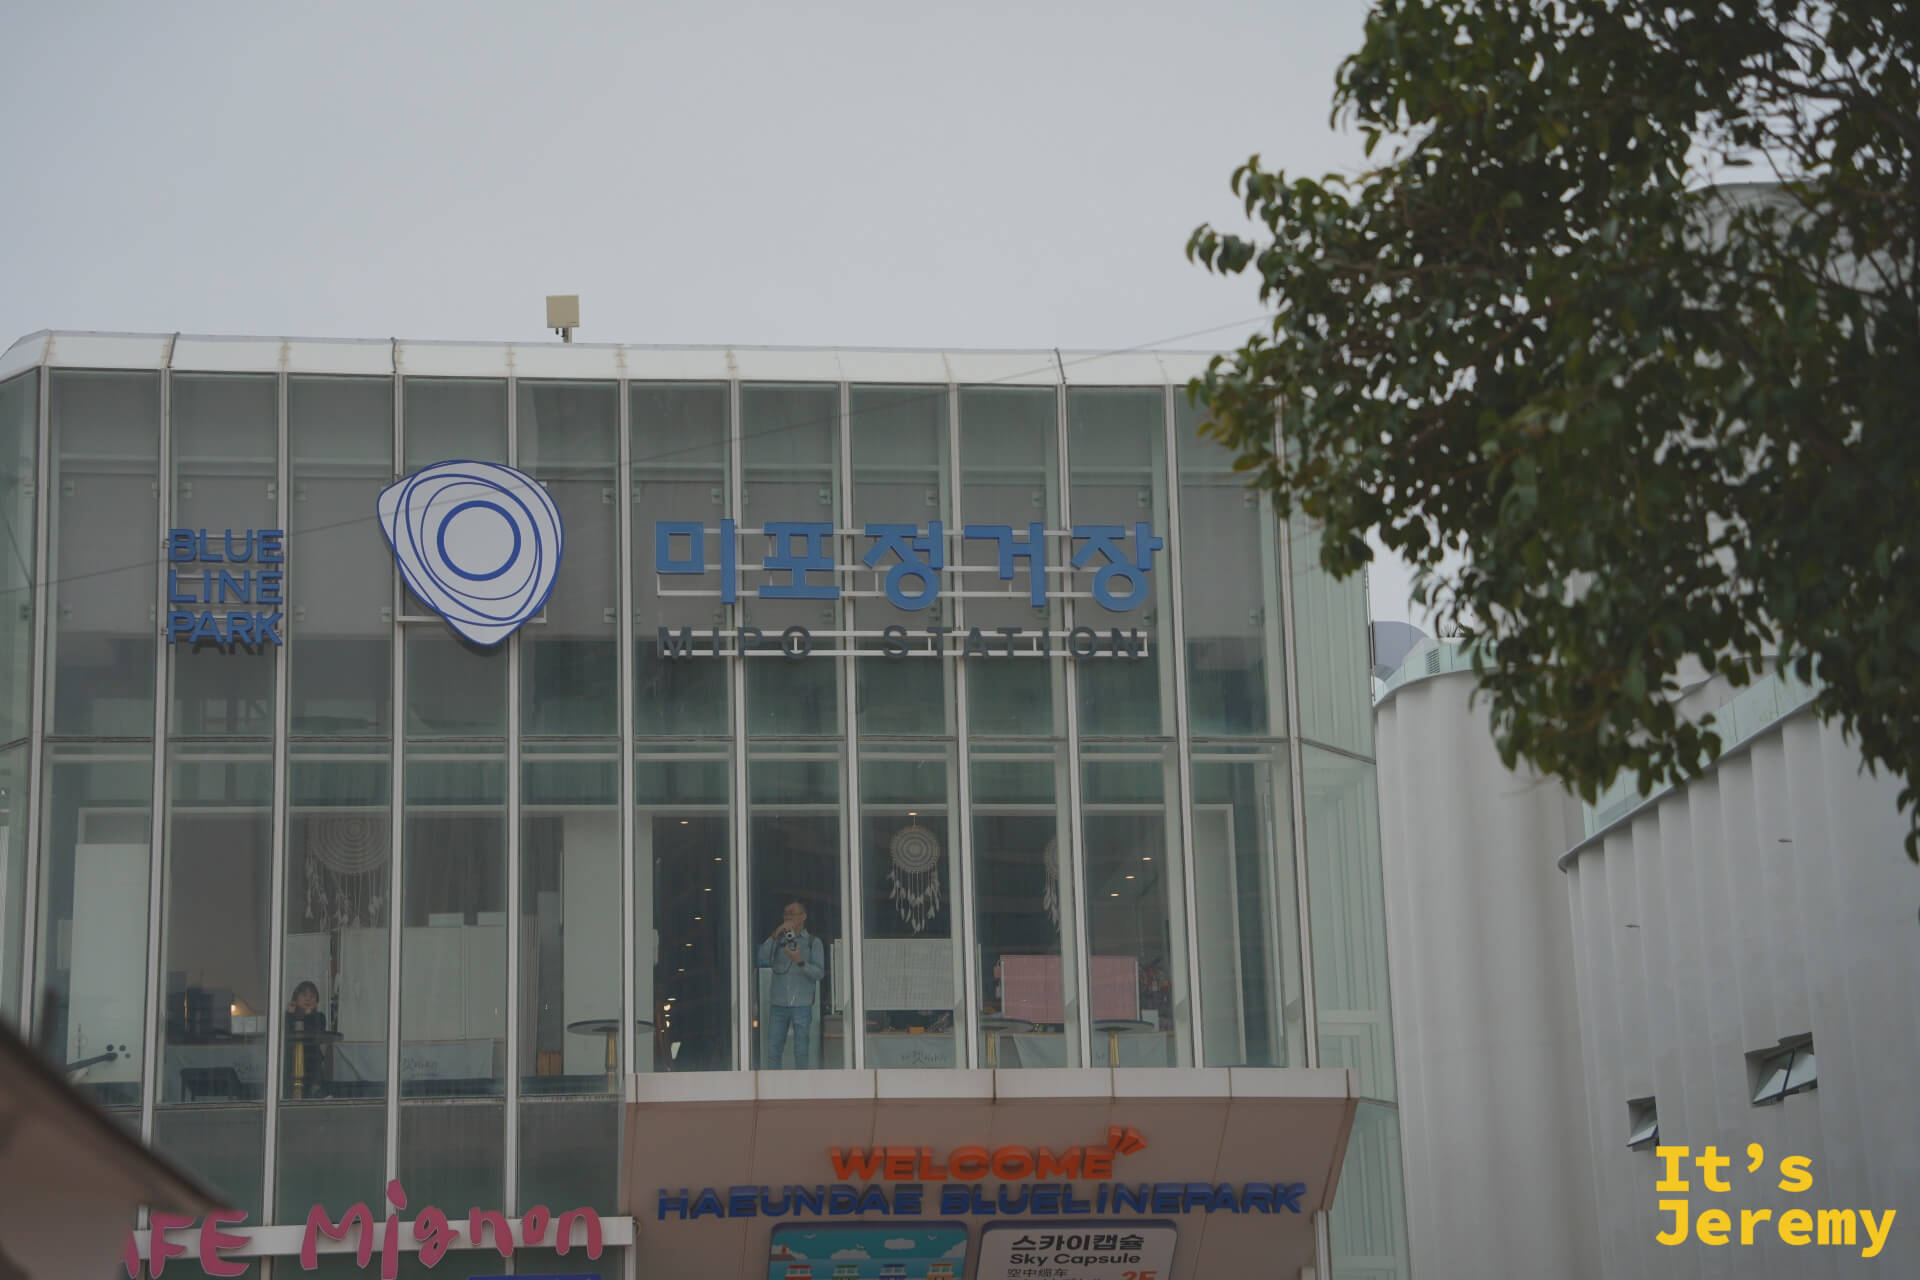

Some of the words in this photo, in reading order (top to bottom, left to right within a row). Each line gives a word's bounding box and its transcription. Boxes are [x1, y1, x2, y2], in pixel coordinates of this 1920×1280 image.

[167, 528, 284, 563] BLUE
[655, 518, 1163, 611] 미포정거장
[167, 569, 283, 604] LINE
[166, 610, 283, 646] PARK
[656, 626, 812, 660] MIPO
[883, 625, 1140, 660] STATION
[830, 1146, 1114, 1180] WELCOME
[657, 1184, 924, 1220] HAEUNDAE
[1009, 1254, 1049, 1267] Sky
[1054, 1253, 1141, 1267] Capsule
[1011, 1234, 1145, 1251] 스카이캡슐
